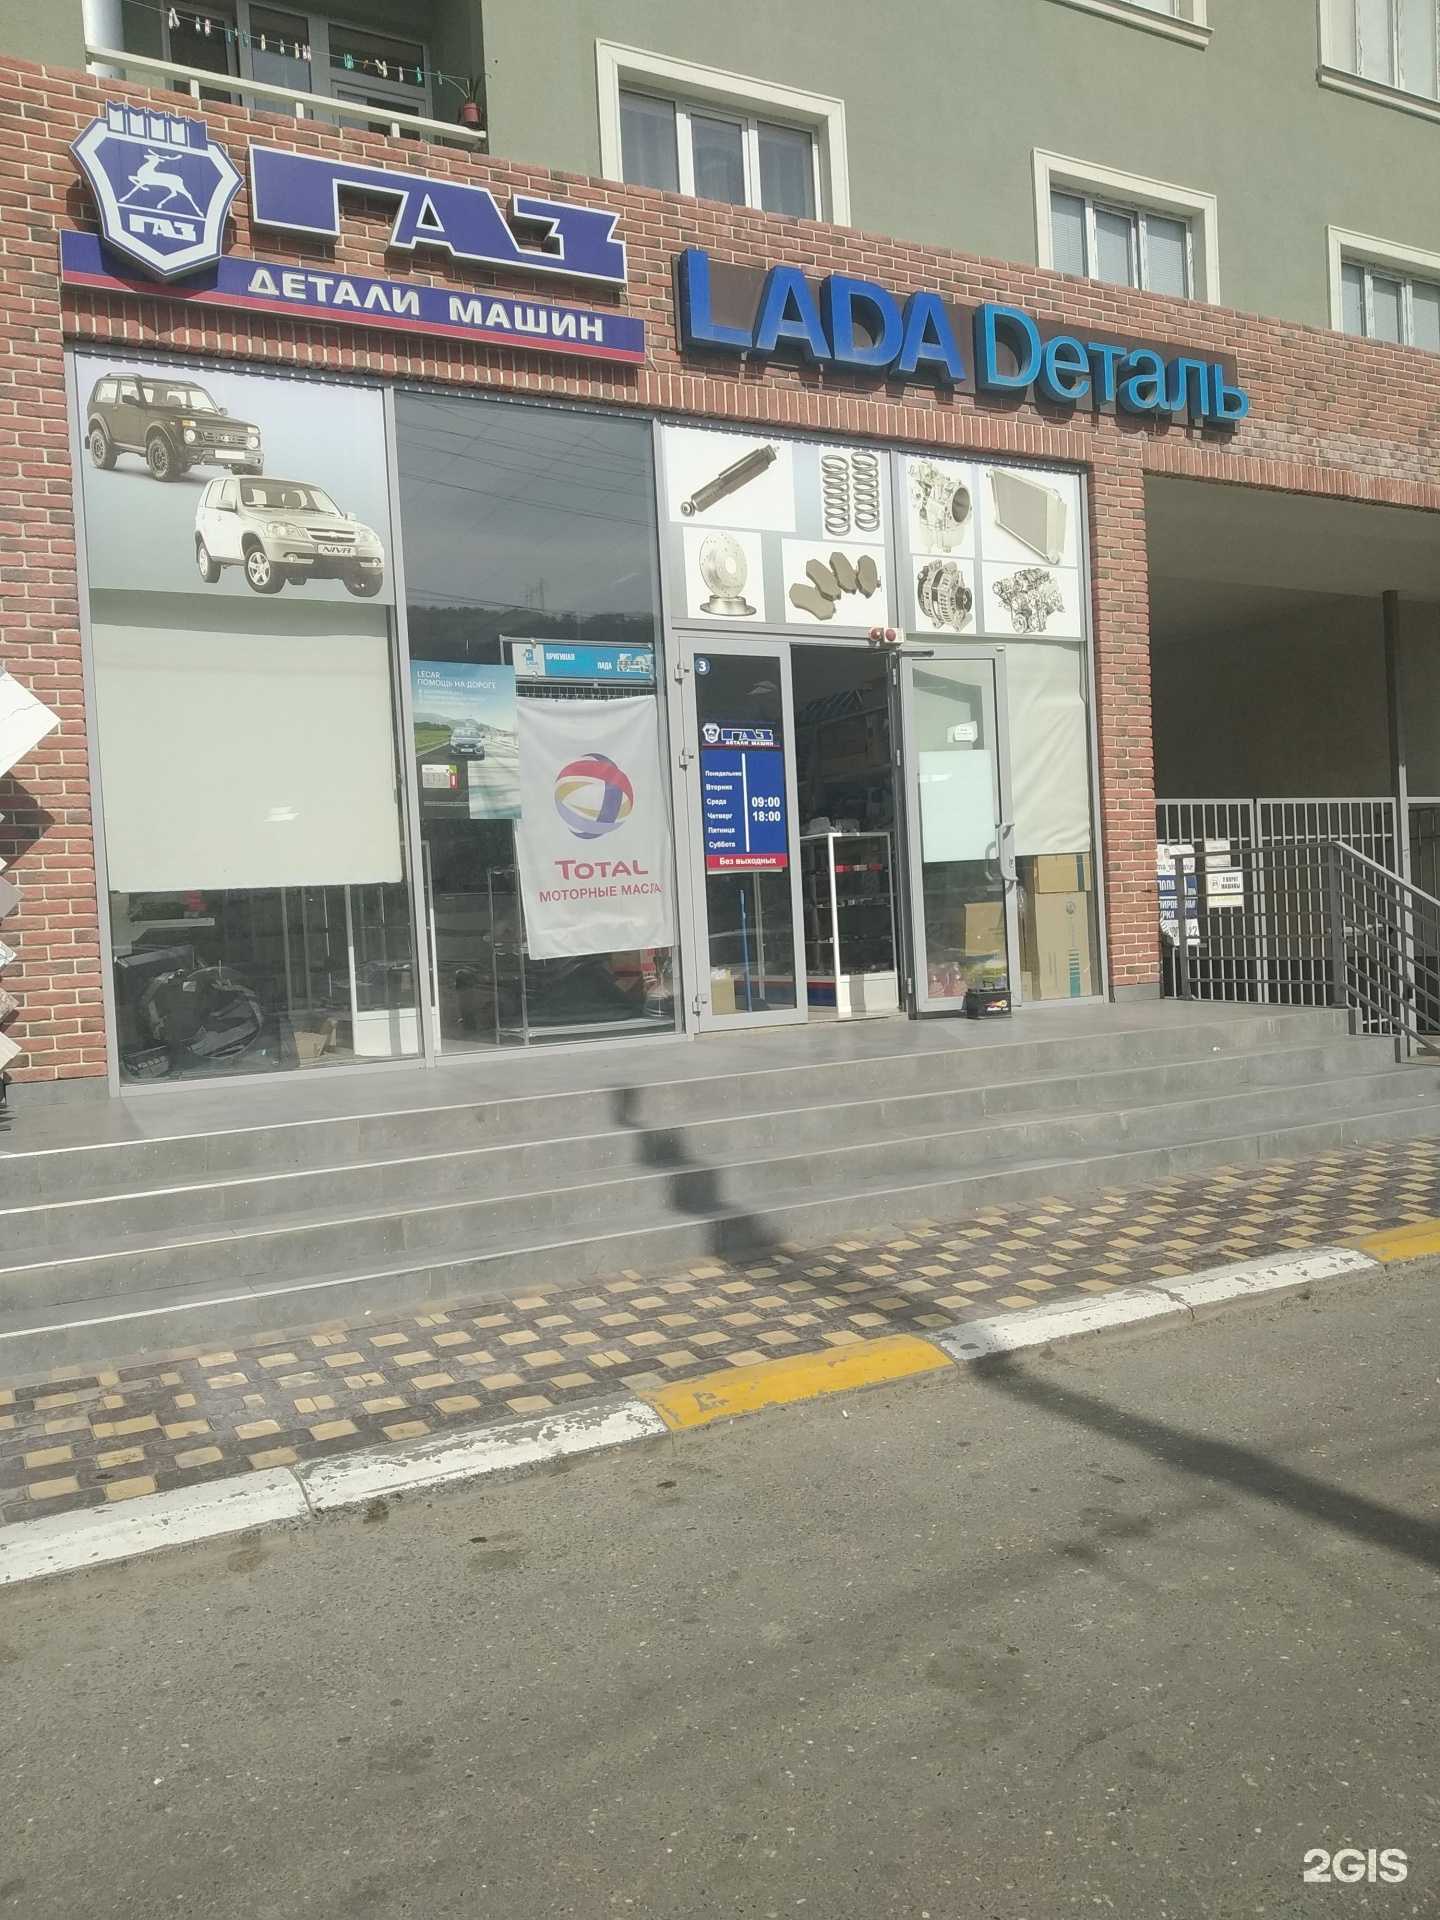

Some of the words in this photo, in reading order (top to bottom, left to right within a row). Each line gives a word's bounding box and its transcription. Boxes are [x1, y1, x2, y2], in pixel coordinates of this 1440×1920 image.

[250, 143, 627, 284] ГАЗ
[128, 213, 197, 242] ГАЗ
[247, 267, 421, 318] ДЕТАЛИ
[449, 295, 605, 343] МАШИН
[680, 248, 966, 384] LADA
[721, 728, 774, 741] ГАЗ
[706, 798, 727, 806] Среда
[751, 796, 781, 808] 09:00
[707, 812, 733, 820] Четверг
[752, 810, 781, 822] 18:00
[708, 826, 735, 834] Пятница
[708, 841, 736, 849] Суббота
[719, 857, 734, 865] Без
[735, 857, 777, 866] выходных
[539, 885, 617, 903] МОТОРНЫЕ
